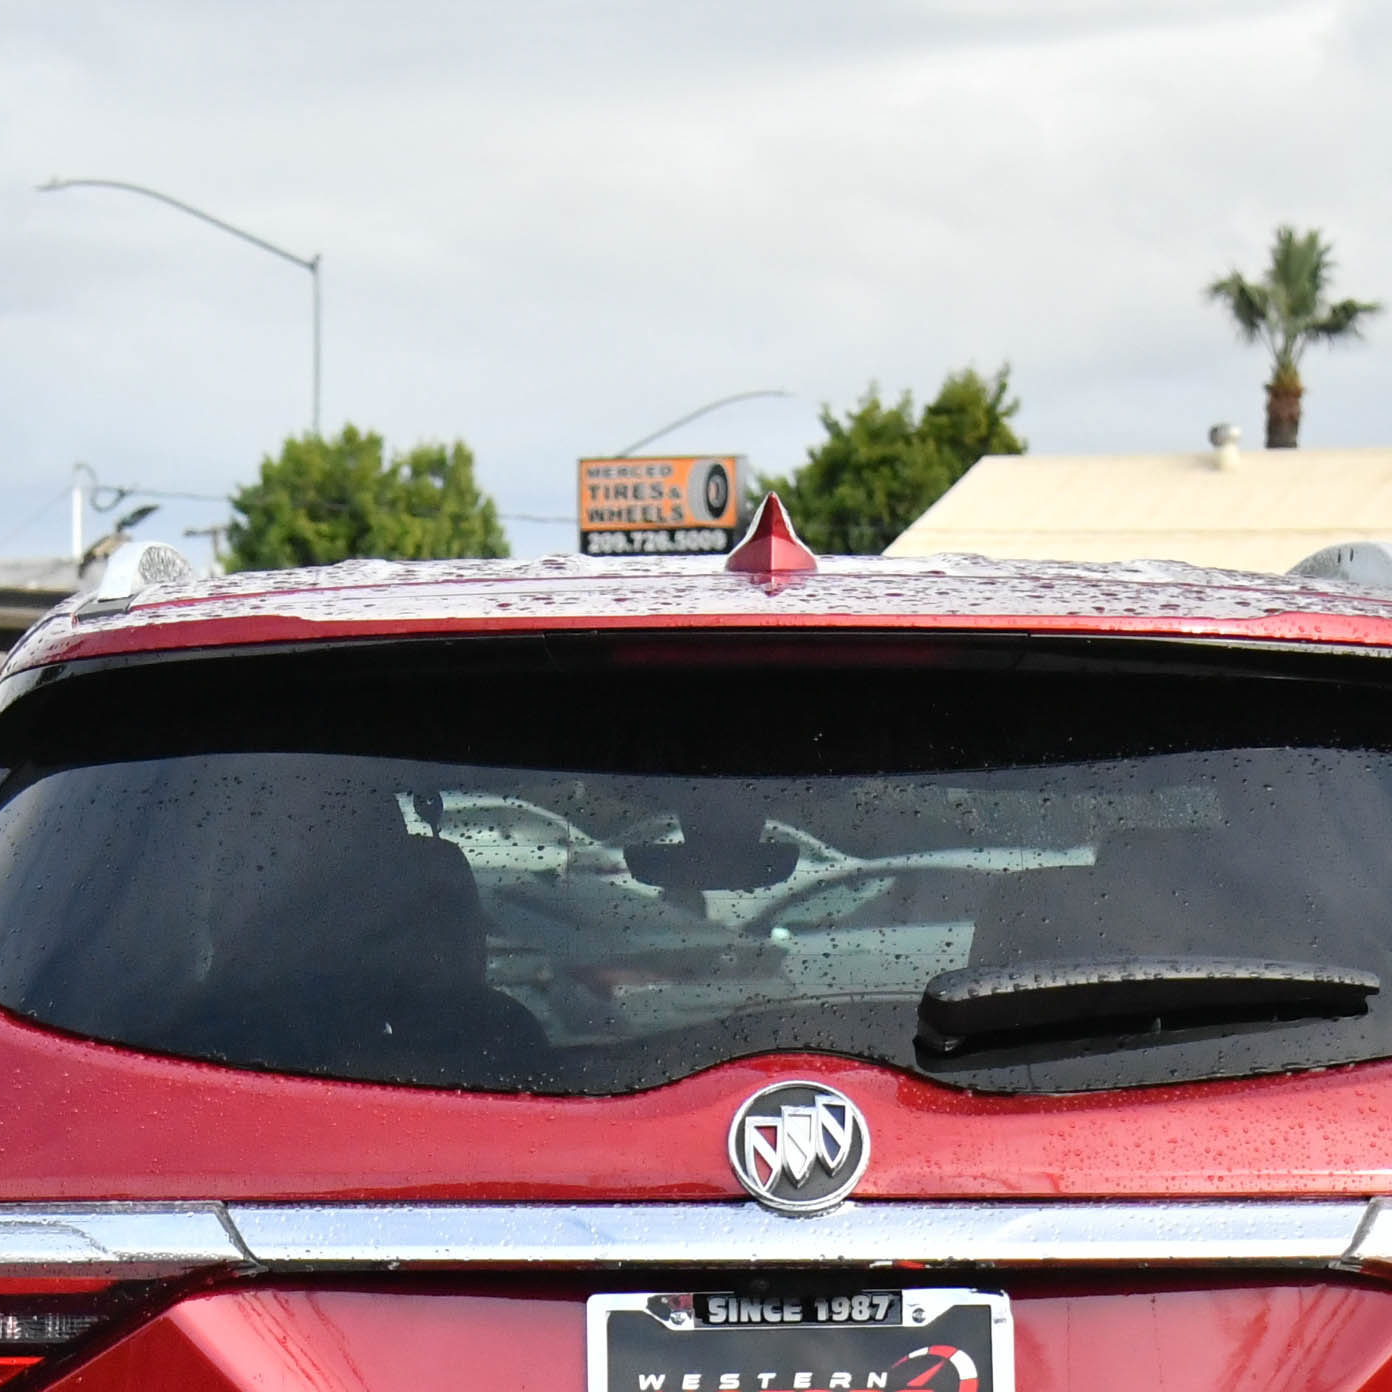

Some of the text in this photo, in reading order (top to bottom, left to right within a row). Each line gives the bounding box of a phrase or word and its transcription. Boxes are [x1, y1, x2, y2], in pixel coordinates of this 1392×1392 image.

[588, 483, 663, 500] TIRES
[588, 505, 684, 523] WHEELS
[708, 1295, 890, 1323] SINCE 1987
[638, 1372, 888, 1390] WESTERN
